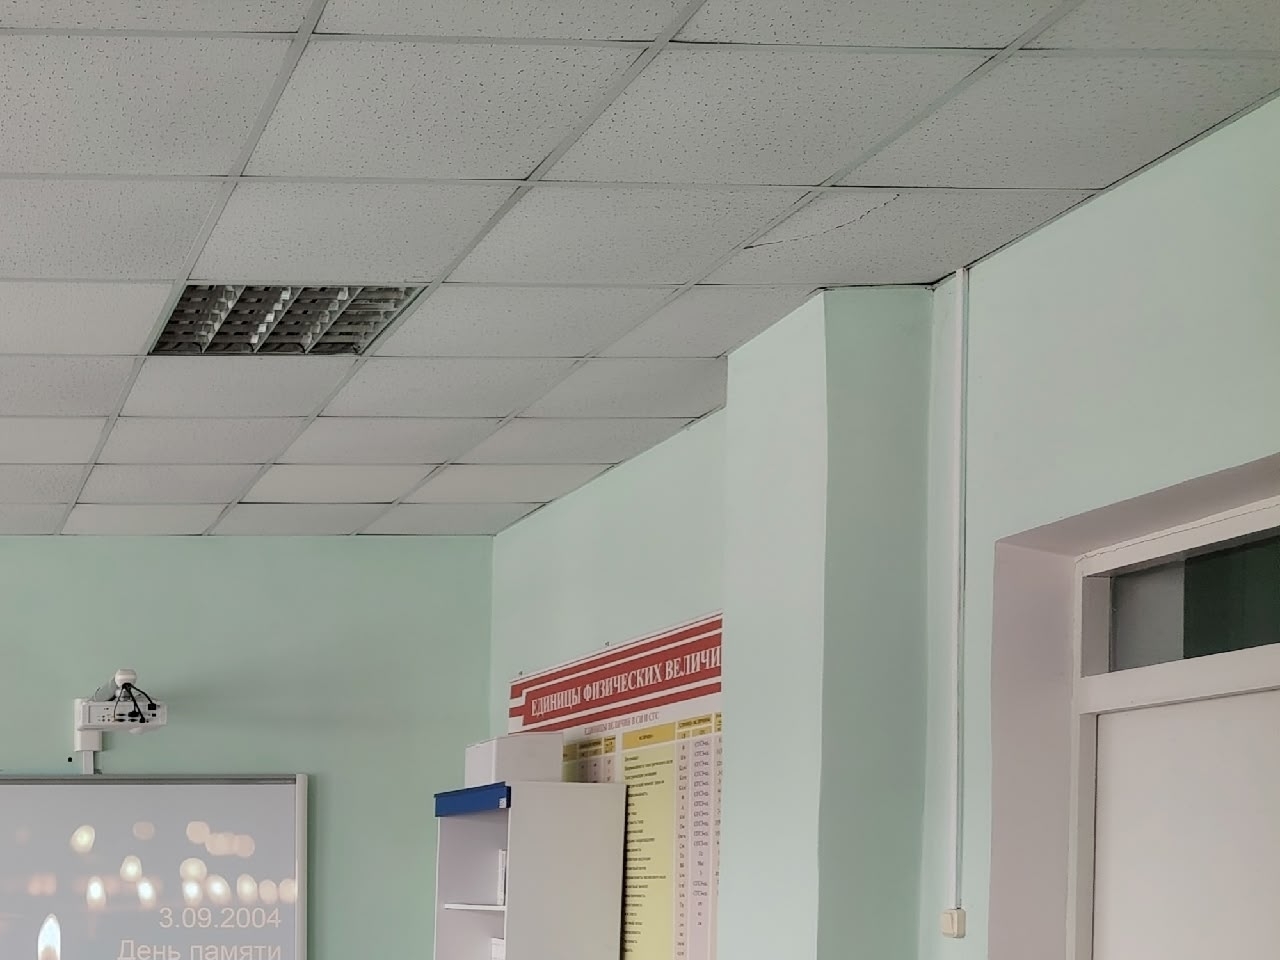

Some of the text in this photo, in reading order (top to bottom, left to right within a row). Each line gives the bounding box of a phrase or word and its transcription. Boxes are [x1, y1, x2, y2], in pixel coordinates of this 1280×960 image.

[531, 686, 581, 718] ЕДИНИЦЫ
[583, 662, 663, 701] ФИЗИЧЕСКИХ
[158, 907, 282, 929] 3.09.2004
